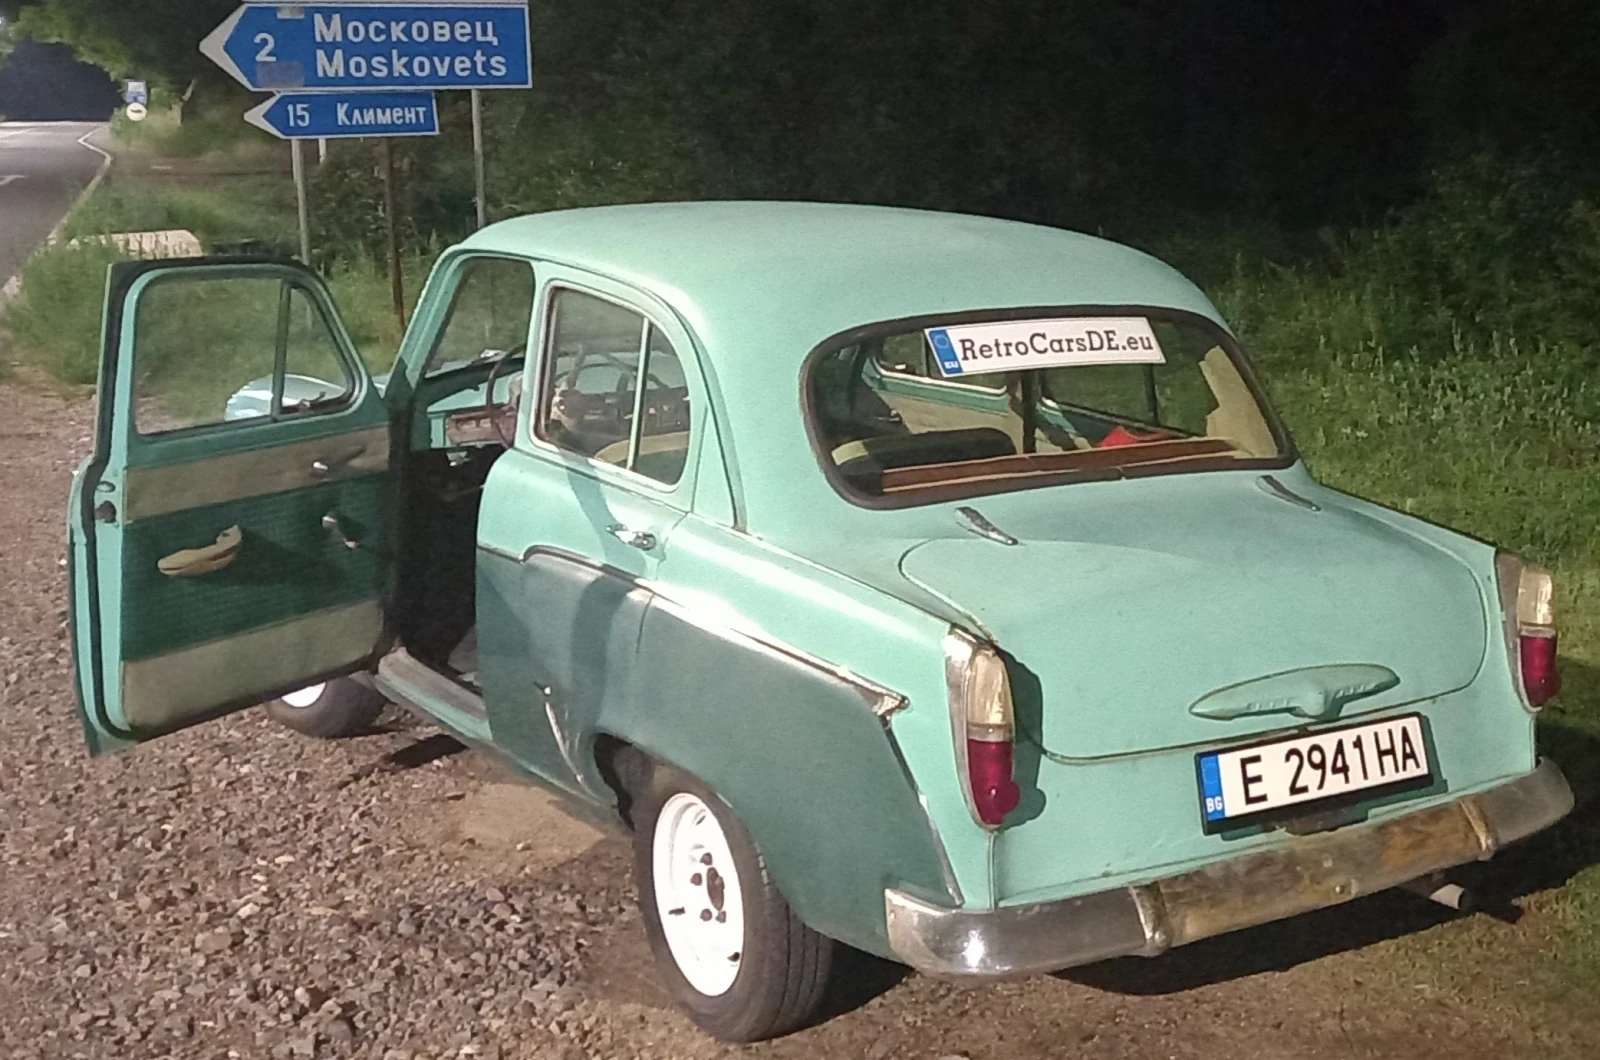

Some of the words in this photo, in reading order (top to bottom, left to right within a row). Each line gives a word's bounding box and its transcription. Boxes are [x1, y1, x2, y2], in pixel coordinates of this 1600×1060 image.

[313, 13, 499, 46] Московец
[253, 33, 277, 62] 2
[316, 49, 508, 78] Moskovets
[286, 103, 311, 127] 15
[336, 102, 427, 126] Климент
[958, 329, 1154, 361] RetroCarsDE.eu
[1240, 754, 1268, 806] E
[1205, 796, 1223, 813] BG
